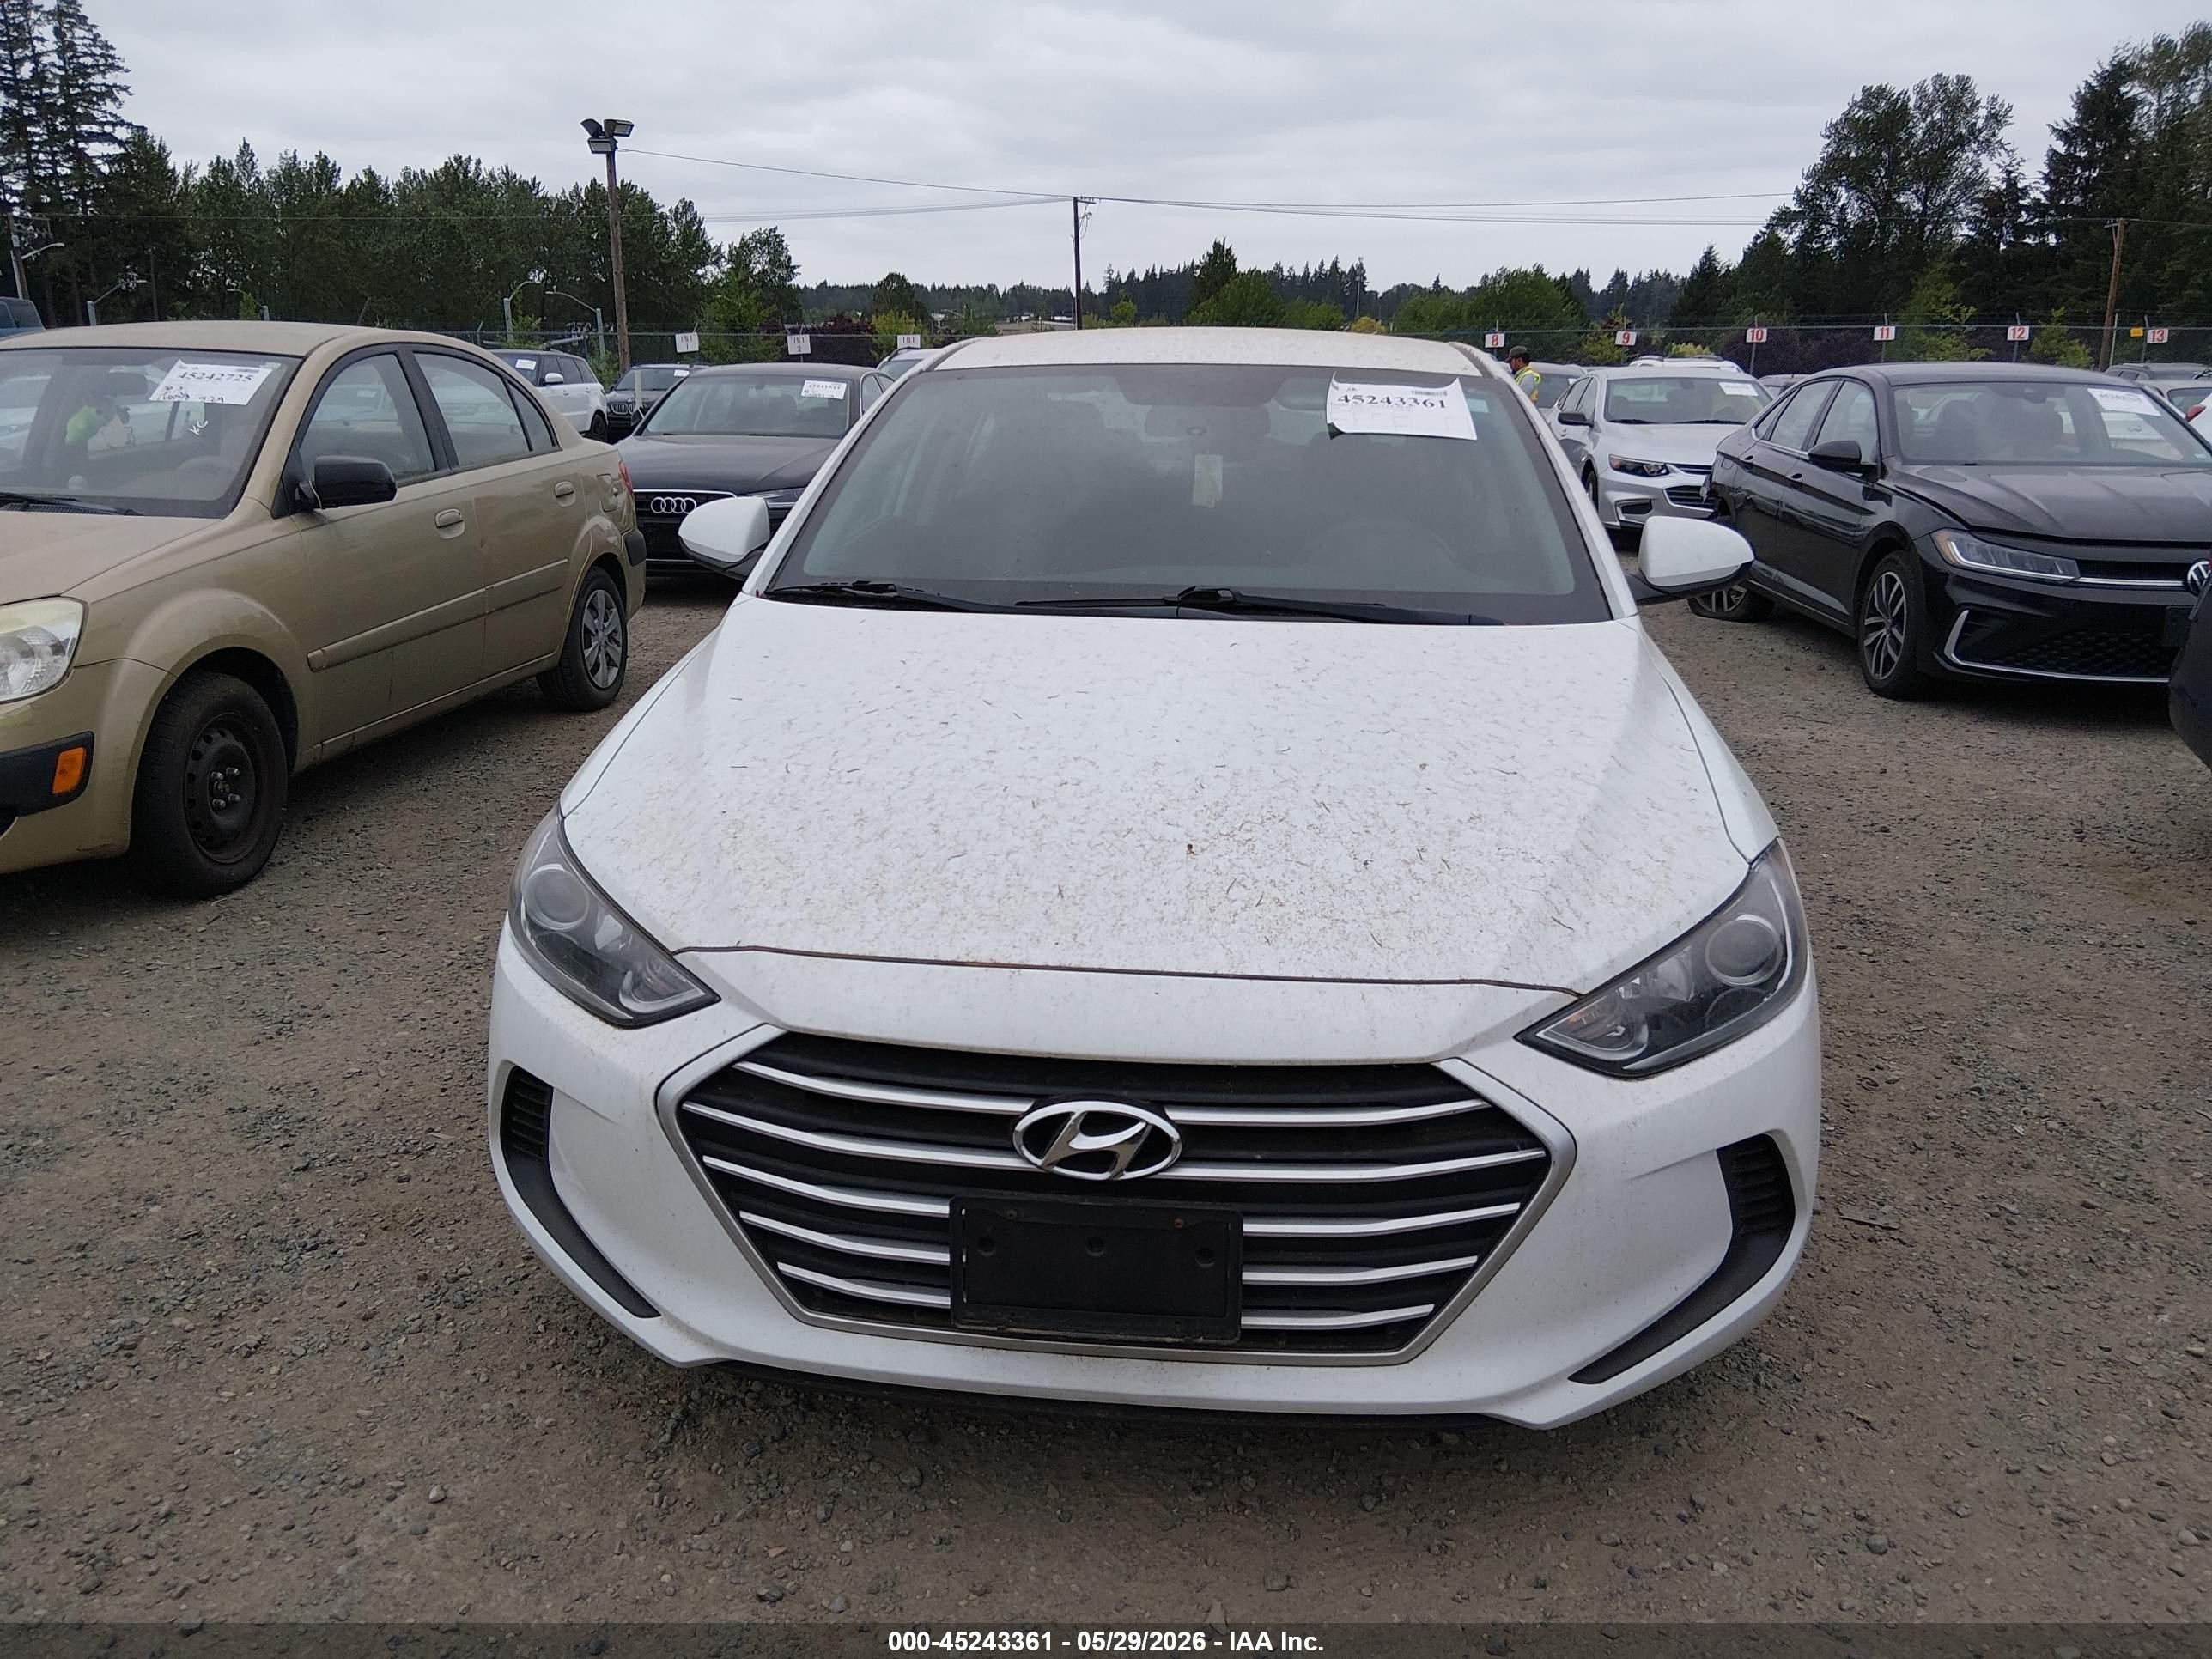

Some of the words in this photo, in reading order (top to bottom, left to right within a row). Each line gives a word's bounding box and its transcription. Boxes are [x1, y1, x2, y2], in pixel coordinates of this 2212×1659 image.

[1622, 331, 1630, 344] 9
[1751, 329, 1764, 341] 10
[1879, 326, 1890, 339] 11
[2011, 327, 2026, 340] 12
[2151, 329, 2165, 343] 13
[1491, 333, 1499, 346] 8
[1337, 394, 1447, 409] 45243361
